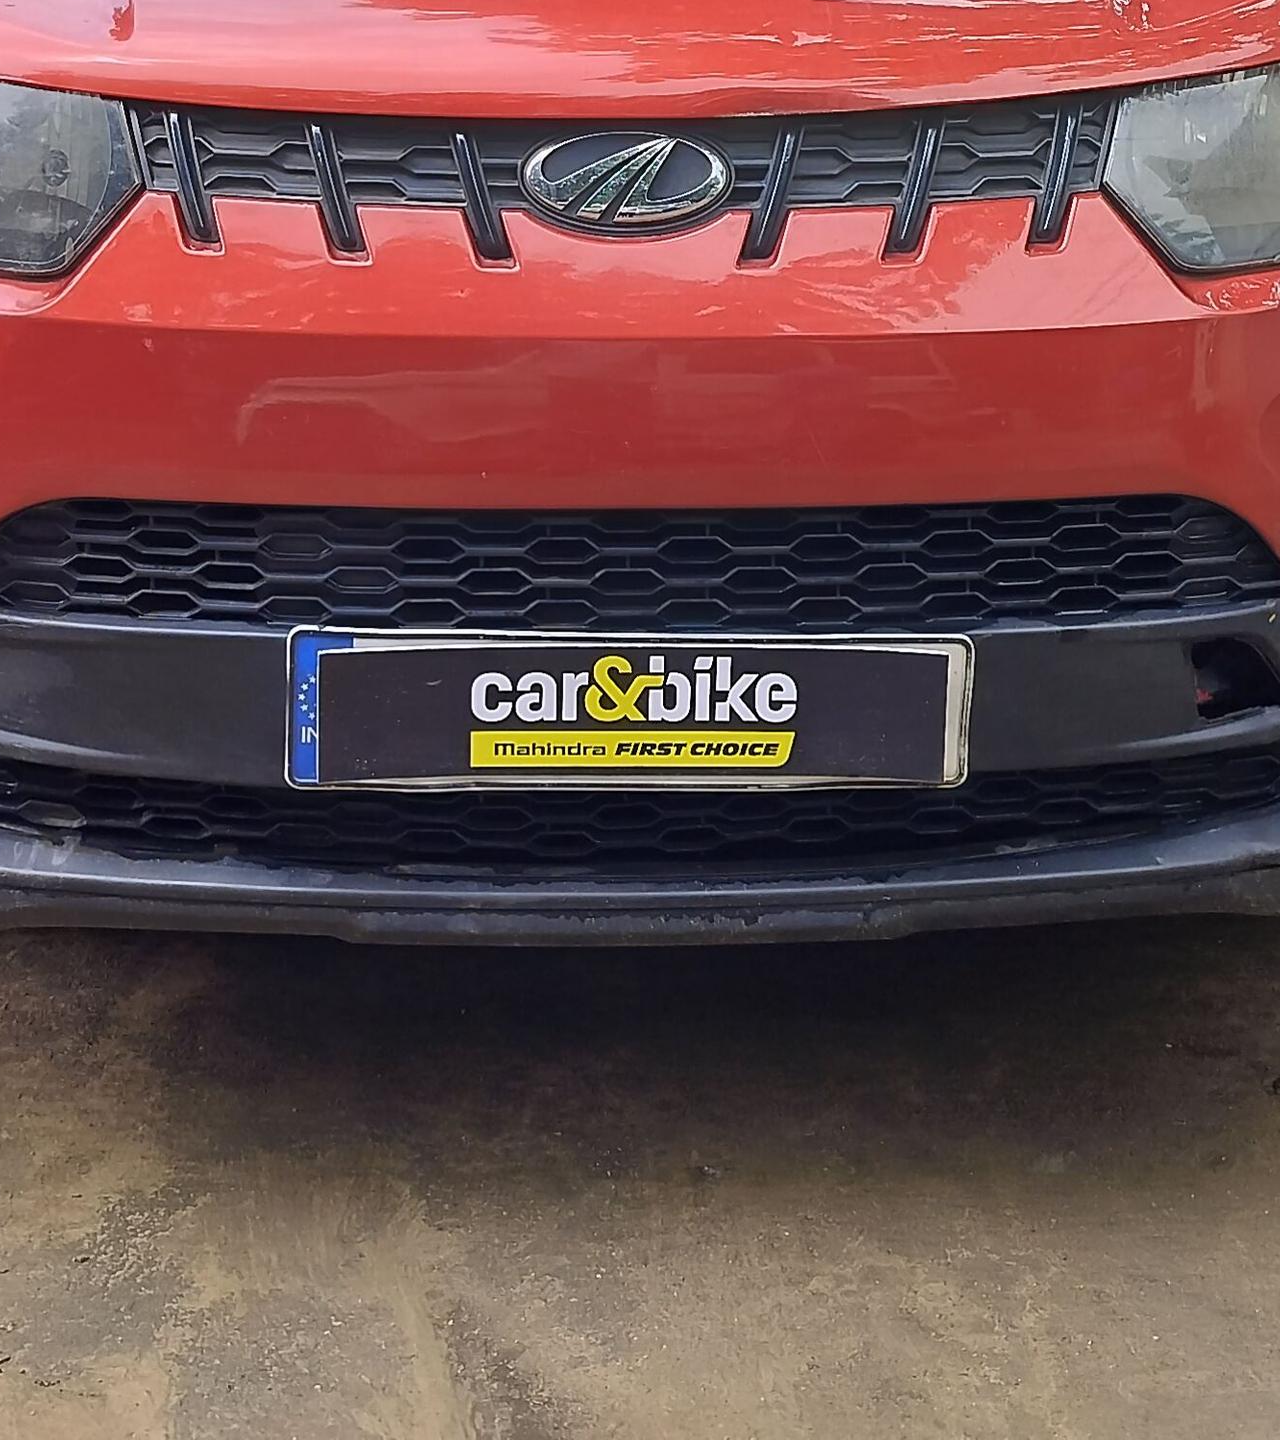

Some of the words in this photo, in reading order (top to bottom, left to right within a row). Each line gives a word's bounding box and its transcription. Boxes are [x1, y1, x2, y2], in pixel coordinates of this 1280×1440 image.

[470, 655, 798, 723] car&bike
[494, 742, 606, 756] Mahindra
[615, 742, 688, 756] FIRST
[690, 742, 780, 756] CHOICE
